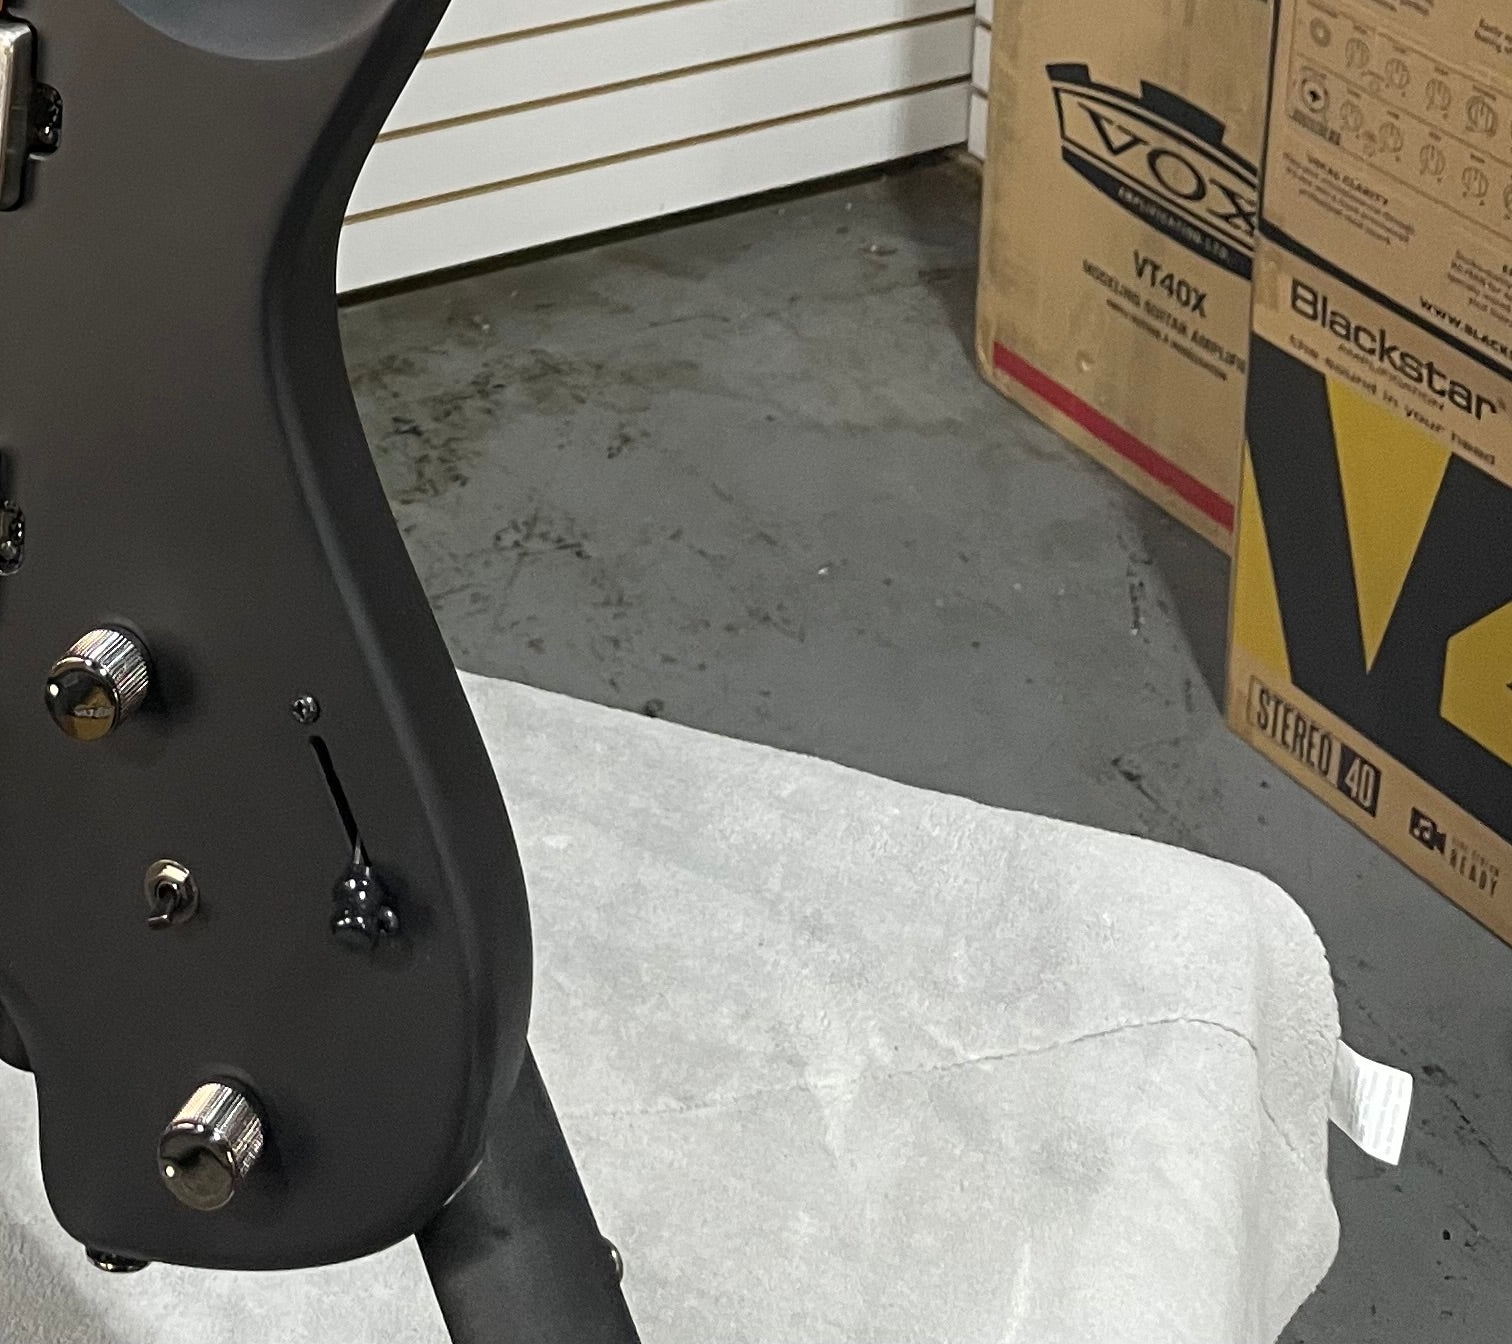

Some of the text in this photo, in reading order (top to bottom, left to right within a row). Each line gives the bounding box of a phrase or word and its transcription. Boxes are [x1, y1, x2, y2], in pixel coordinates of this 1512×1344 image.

[1133, 248, 1208, 319] VT40X
[1291, 277, 1497, 421] Blackstar
[1256, 687, 1376, 809] STEREO 40
